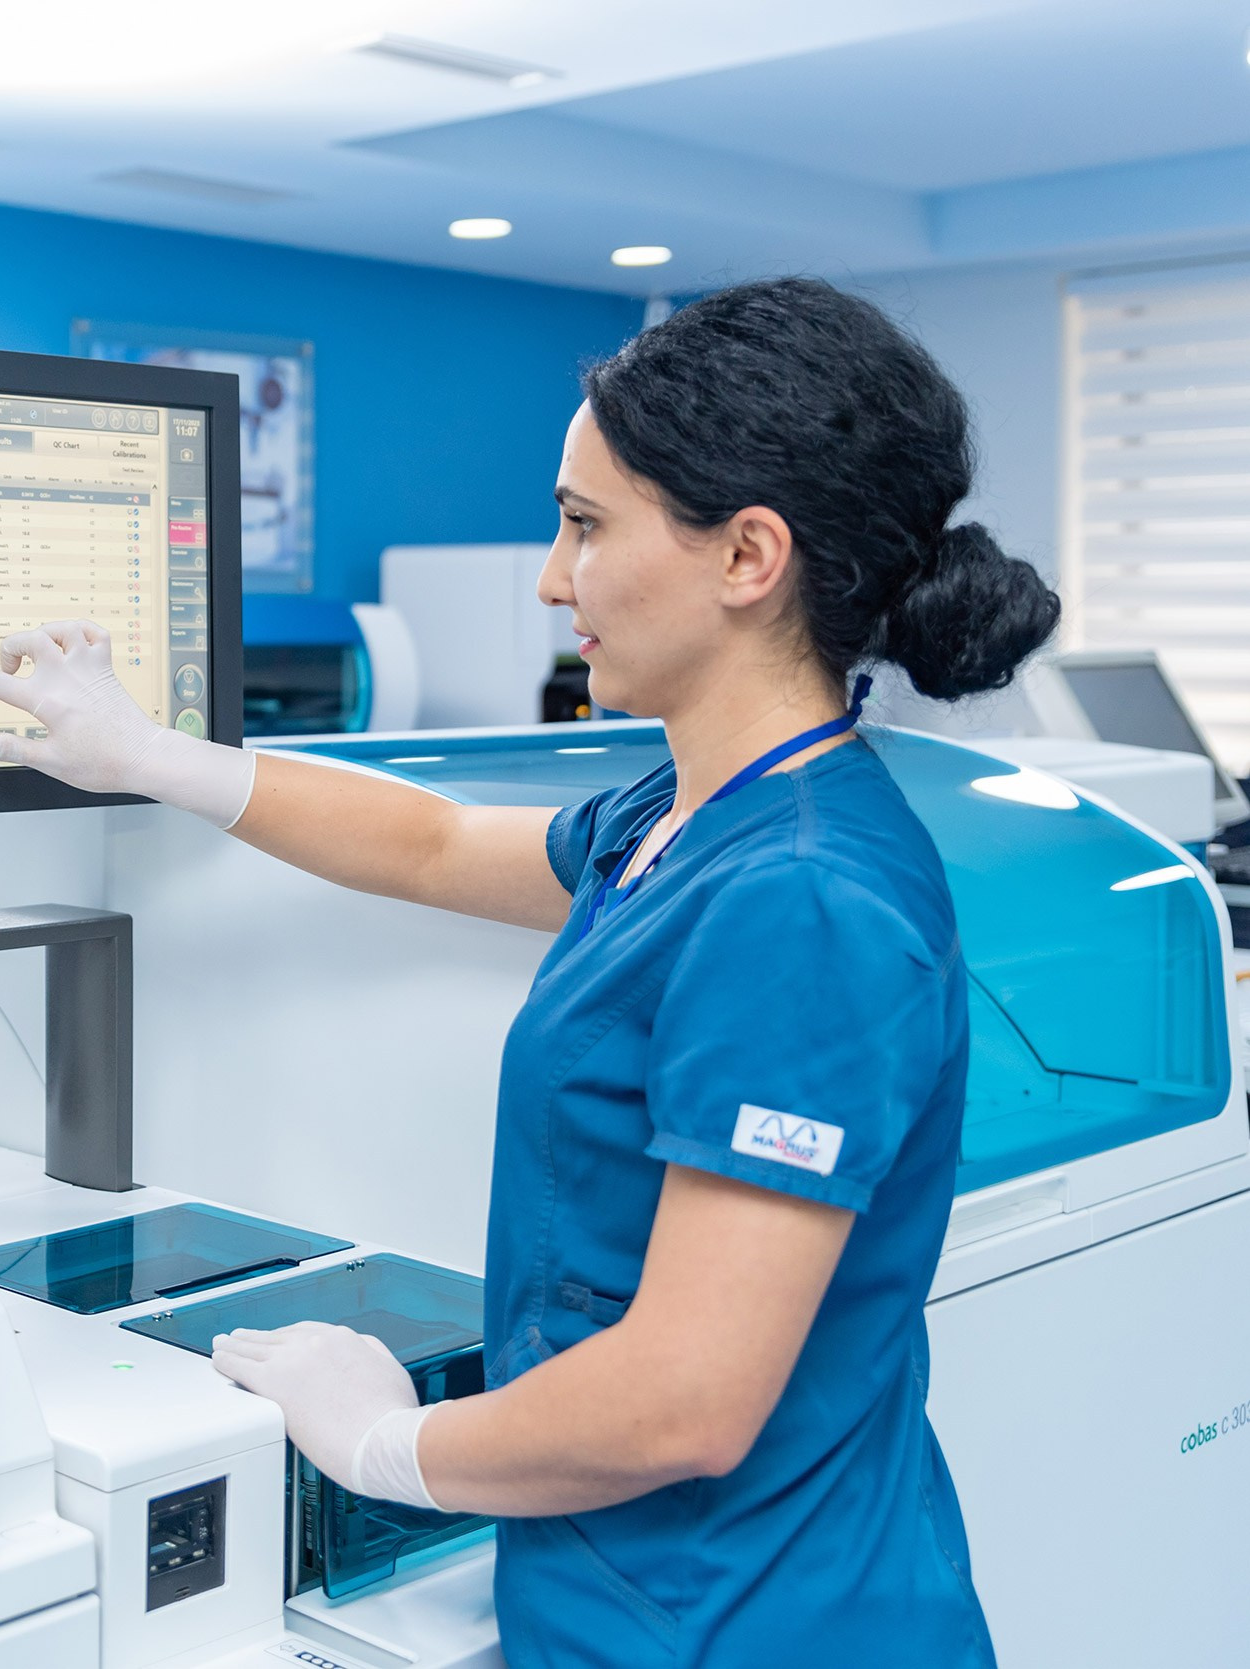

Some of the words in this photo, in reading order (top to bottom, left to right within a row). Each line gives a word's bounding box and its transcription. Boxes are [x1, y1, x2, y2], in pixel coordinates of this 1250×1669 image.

[176, 426, 198, 437] 11:07
[53, 441, 62, 449] QC
[63, 442, 80, 450] Chart
[120, 440, 139, 448] Recent
[112, 450, 147, 459] Calibrations
[183, 689, 196, 697] Stop
[1180, 1422, 1217, 1454] cobas
[1221, 1416, 1228, 1434] c
